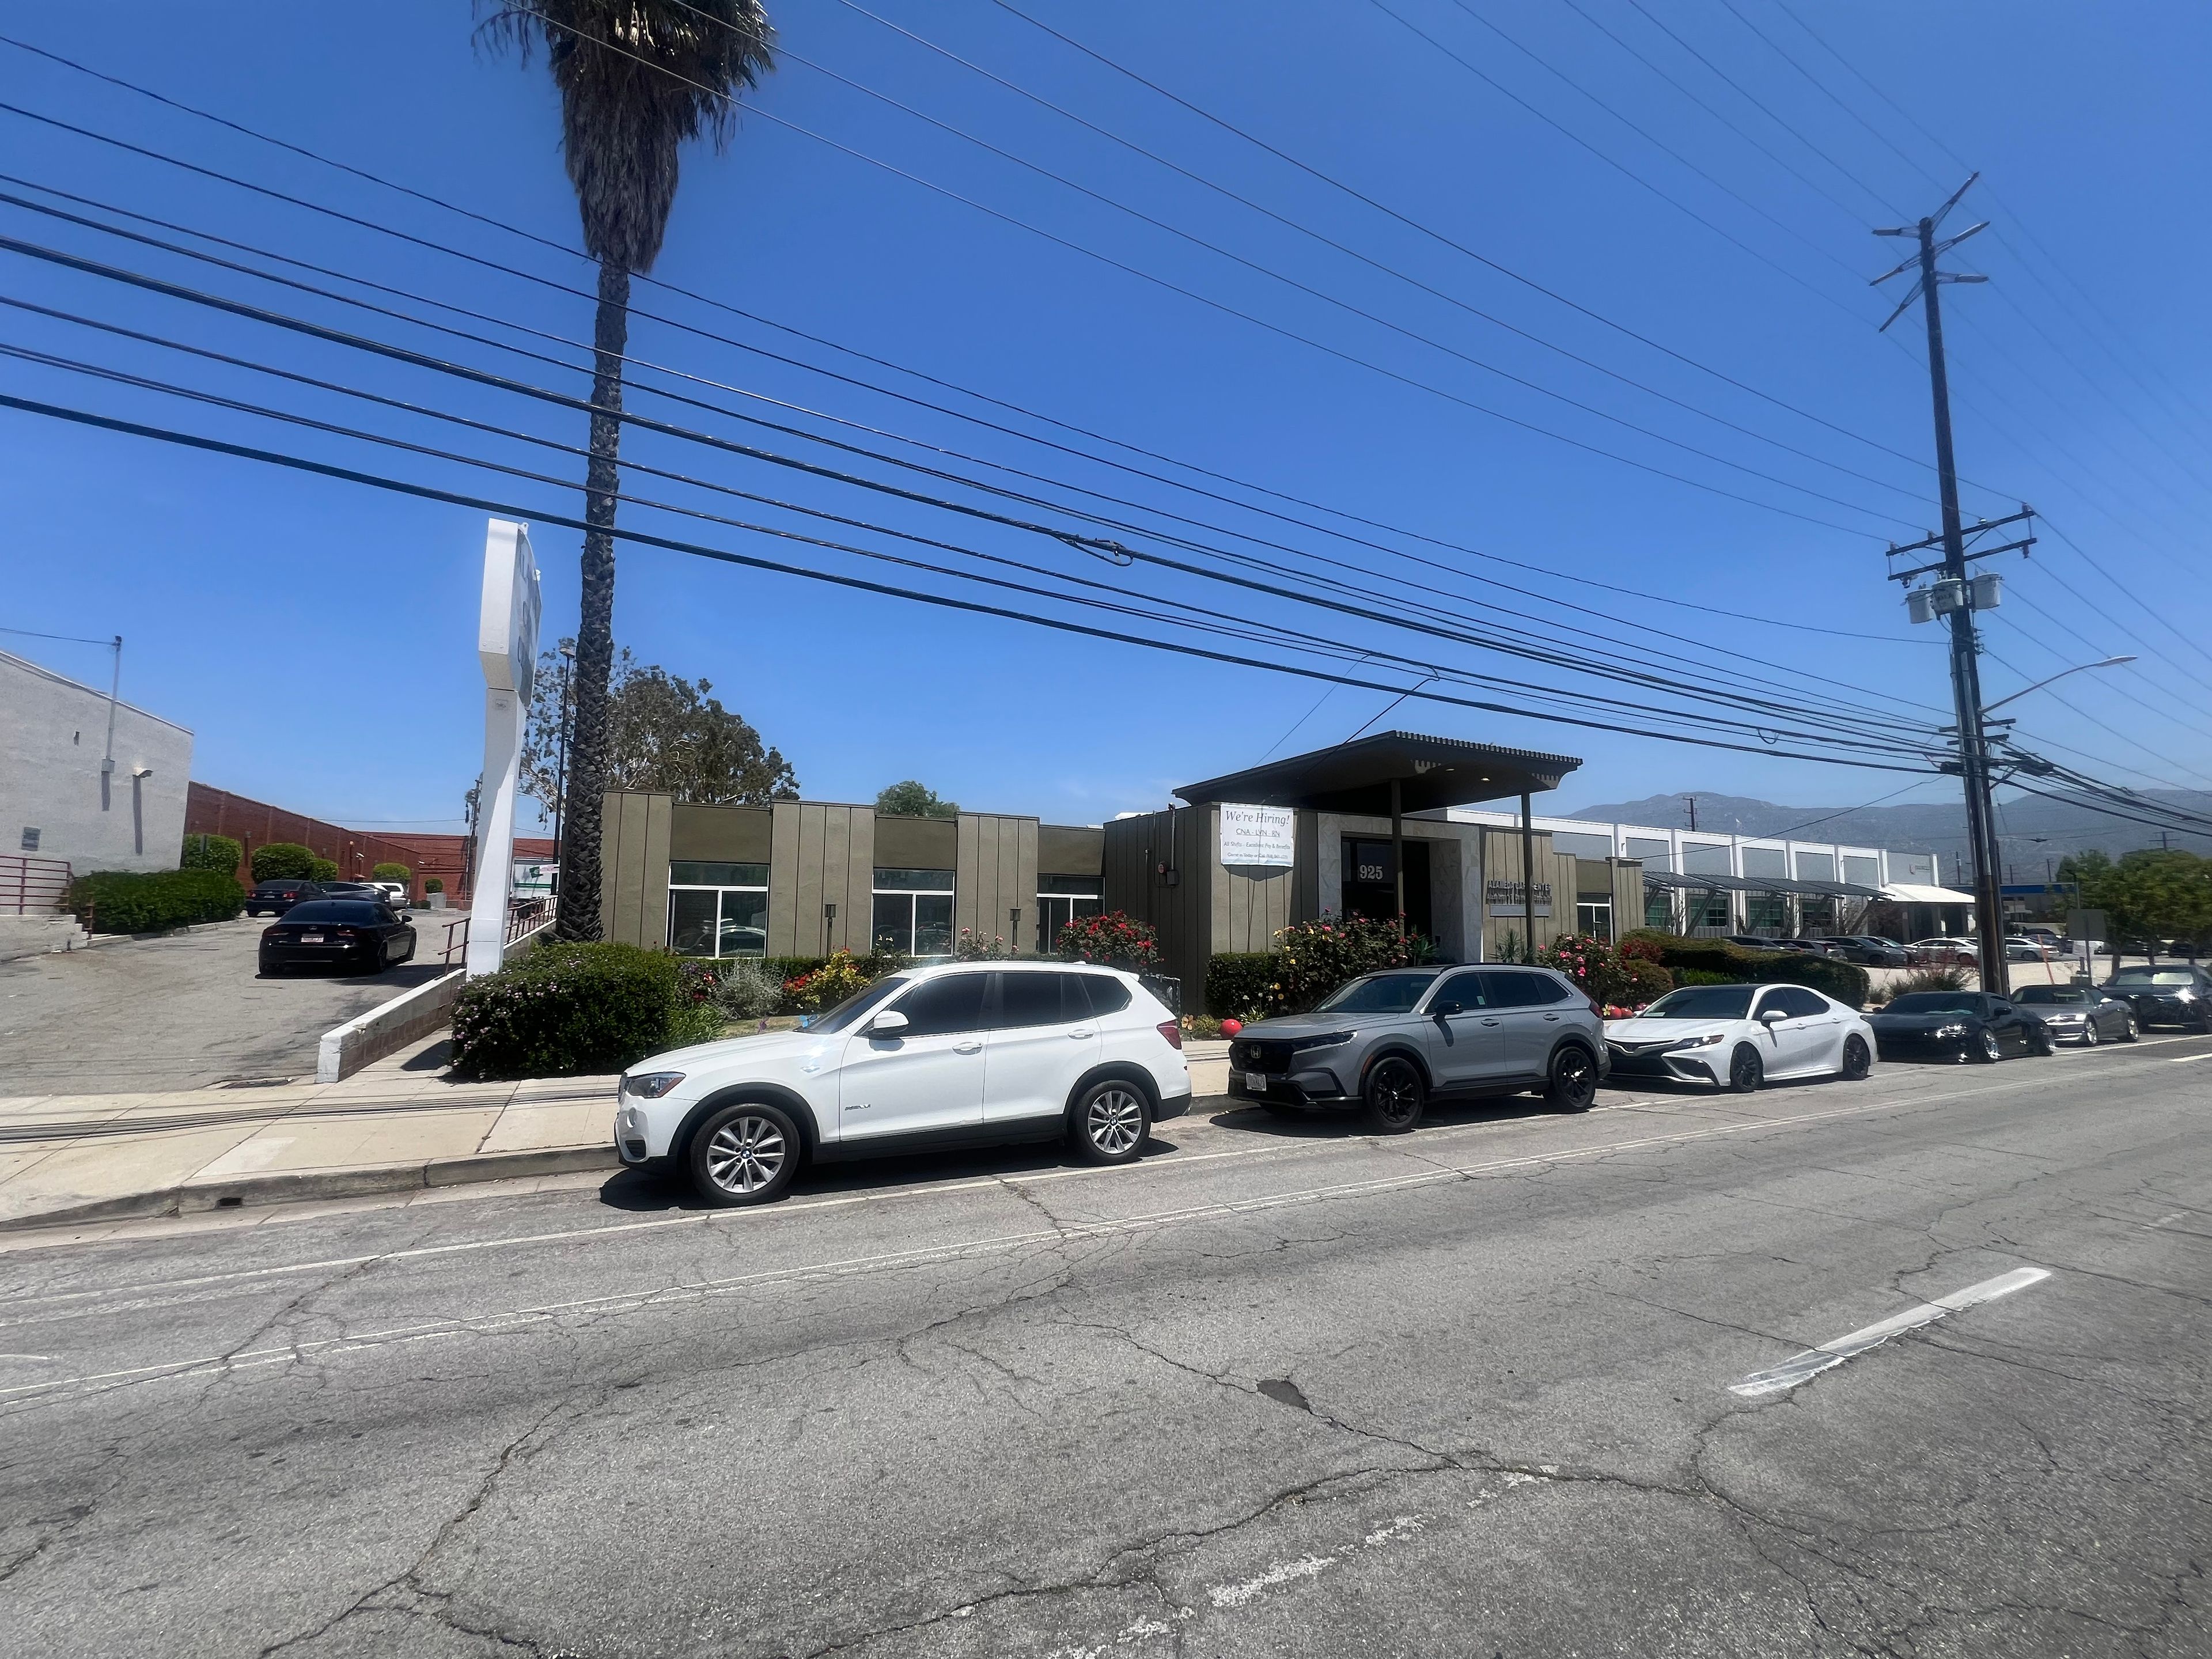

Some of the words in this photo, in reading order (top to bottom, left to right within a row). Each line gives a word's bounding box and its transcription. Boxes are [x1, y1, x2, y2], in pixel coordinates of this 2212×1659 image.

[1226, 810, 1253, 822] We're
[1255, 812, 1290, 827] Hiring!
[1359, 865, 1383, 880] 925
